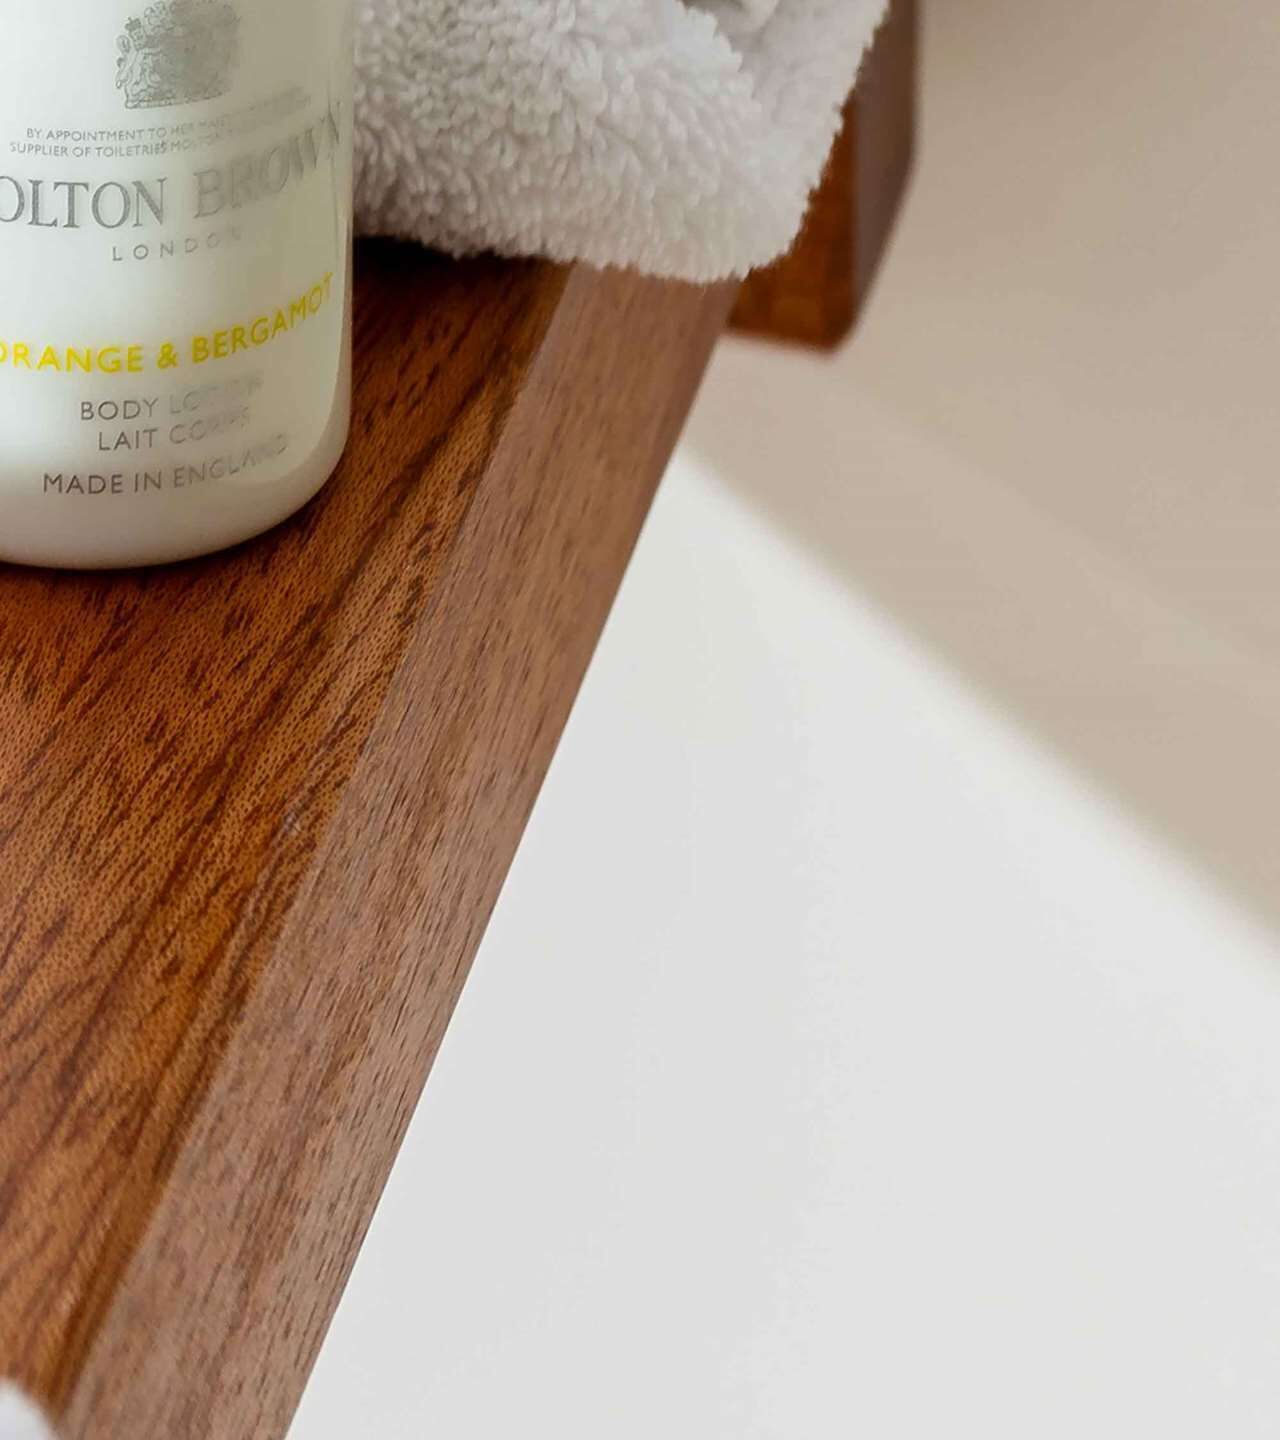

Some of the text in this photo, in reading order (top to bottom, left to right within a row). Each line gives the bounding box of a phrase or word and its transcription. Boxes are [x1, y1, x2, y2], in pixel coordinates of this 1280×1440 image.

[26, 127, 42, 139] BY
[46, 128, 144, 142] APPOINTMENT
[148, 126, 167, 138] TO
[9, 141, 68, 157] SUPPLIER
[72, 146, 91, 158] OF
[95, 141, 167, 158] TOILETRIES
[157, 342, 179, 370] &
[191, 271, 335, 363] BERGAMOT
[80, 398, 159, 421] BODY
[98, 428, 159, 452] LAIT
[43, 473, 123, 495] MADE
[134, 470, 162, 492] IN
